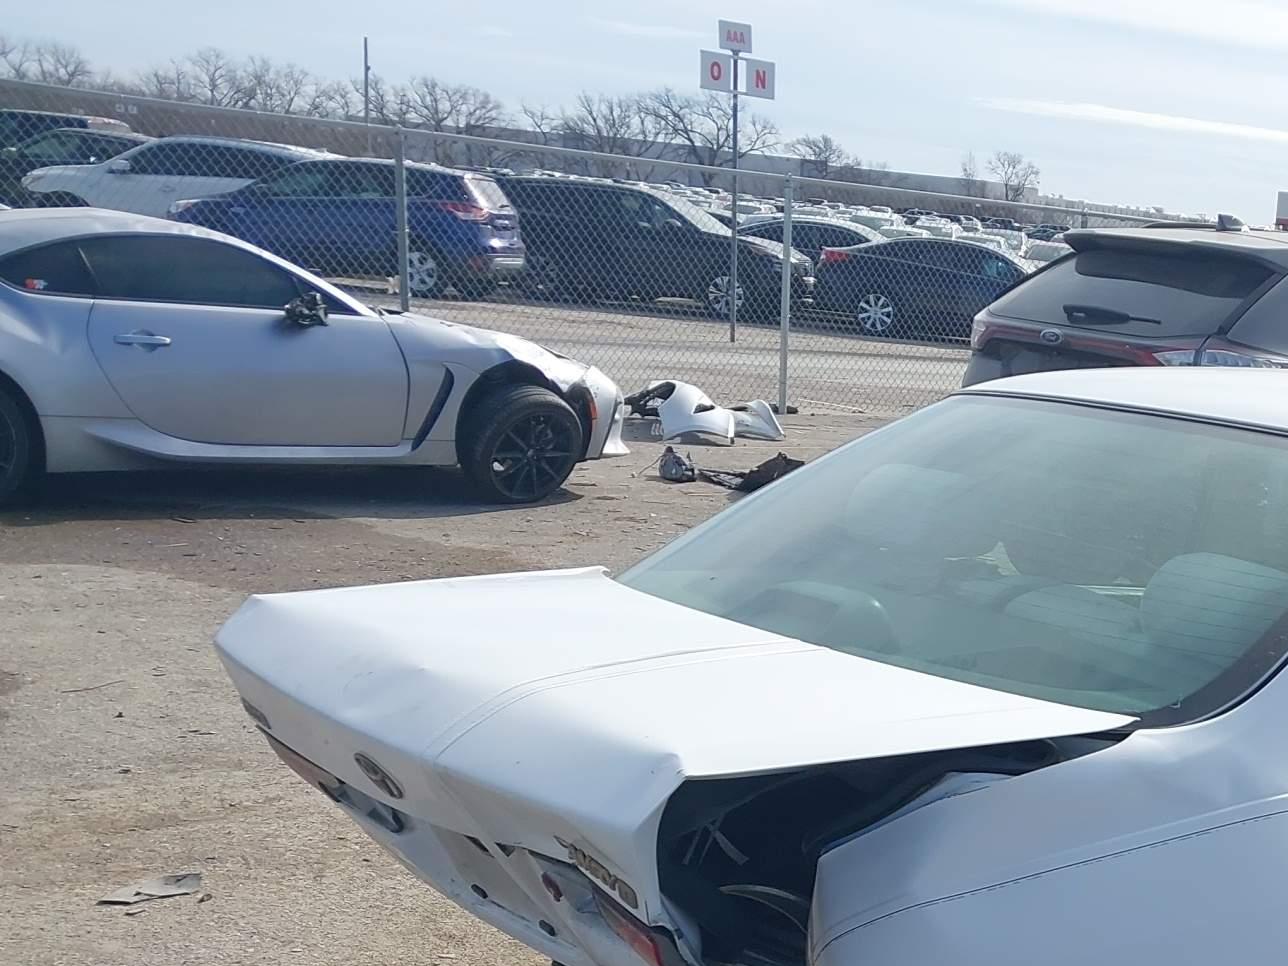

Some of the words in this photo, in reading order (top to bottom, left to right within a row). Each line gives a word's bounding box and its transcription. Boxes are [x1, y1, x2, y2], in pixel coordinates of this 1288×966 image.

[726, 30, 745, 44] AAA
[710, 61, 722, 81] O
[755, 69, 767, 89] N
